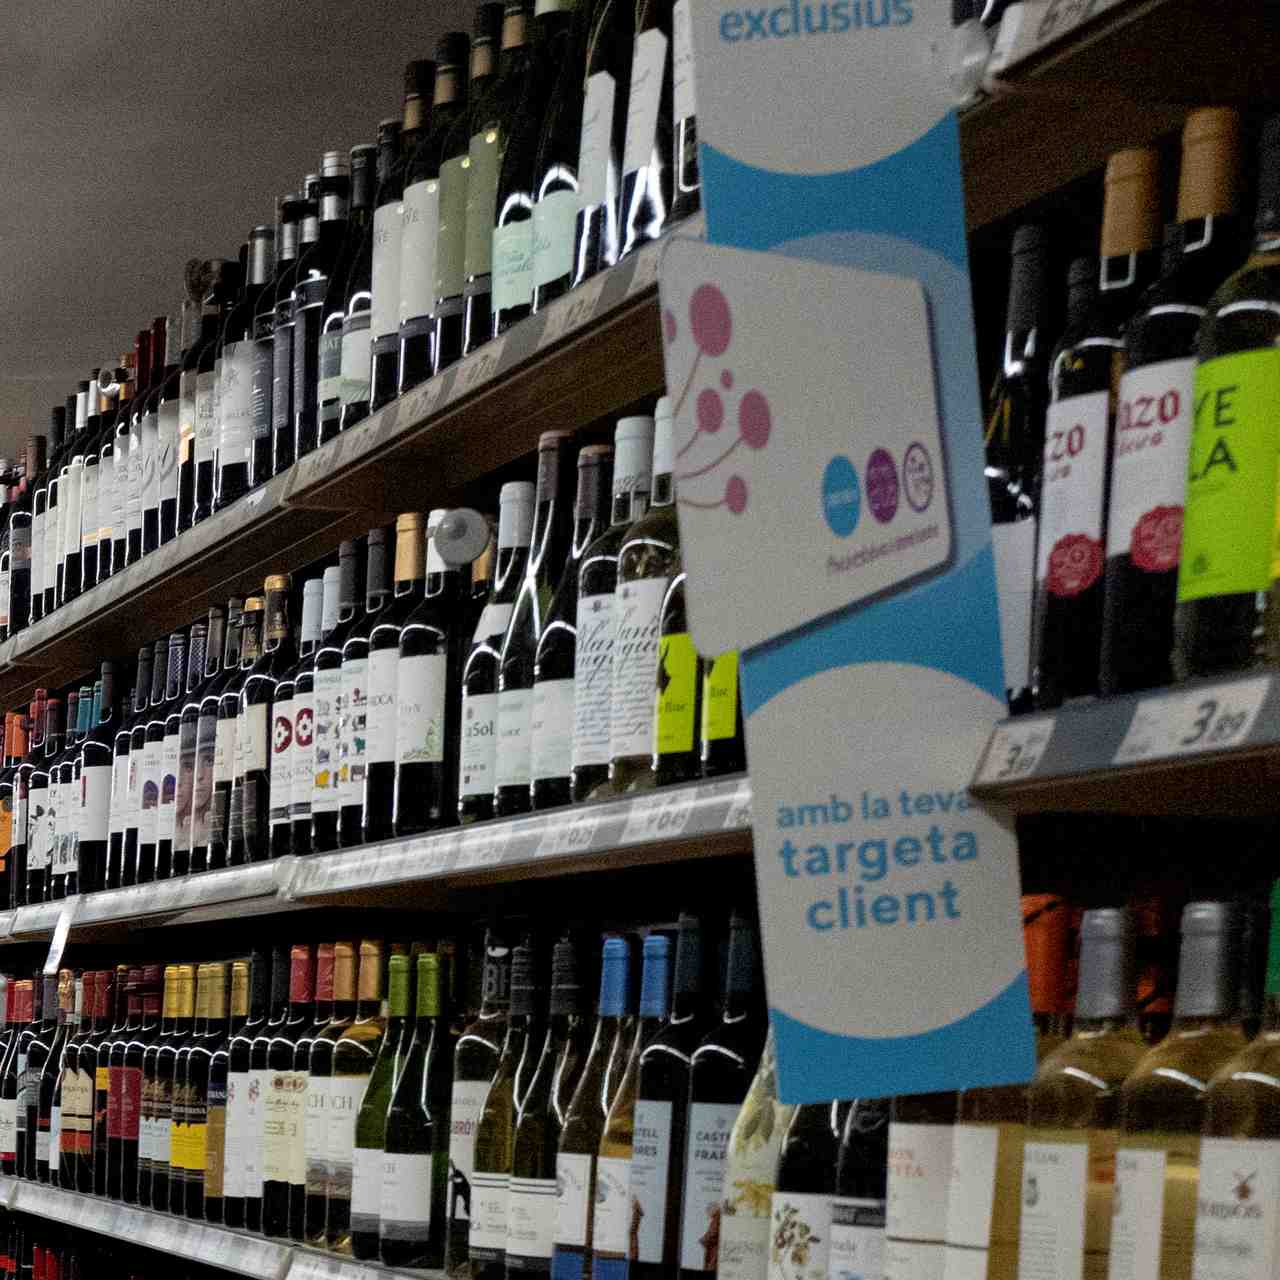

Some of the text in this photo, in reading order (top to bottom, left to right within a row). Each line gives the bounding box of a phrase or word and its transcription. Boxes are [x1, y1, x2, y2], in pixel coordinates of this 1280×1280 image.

[777, 787, 971, 829] amb la teva
[778, 822, 979, 884] targeta
[806, 880, 961, 933] client
